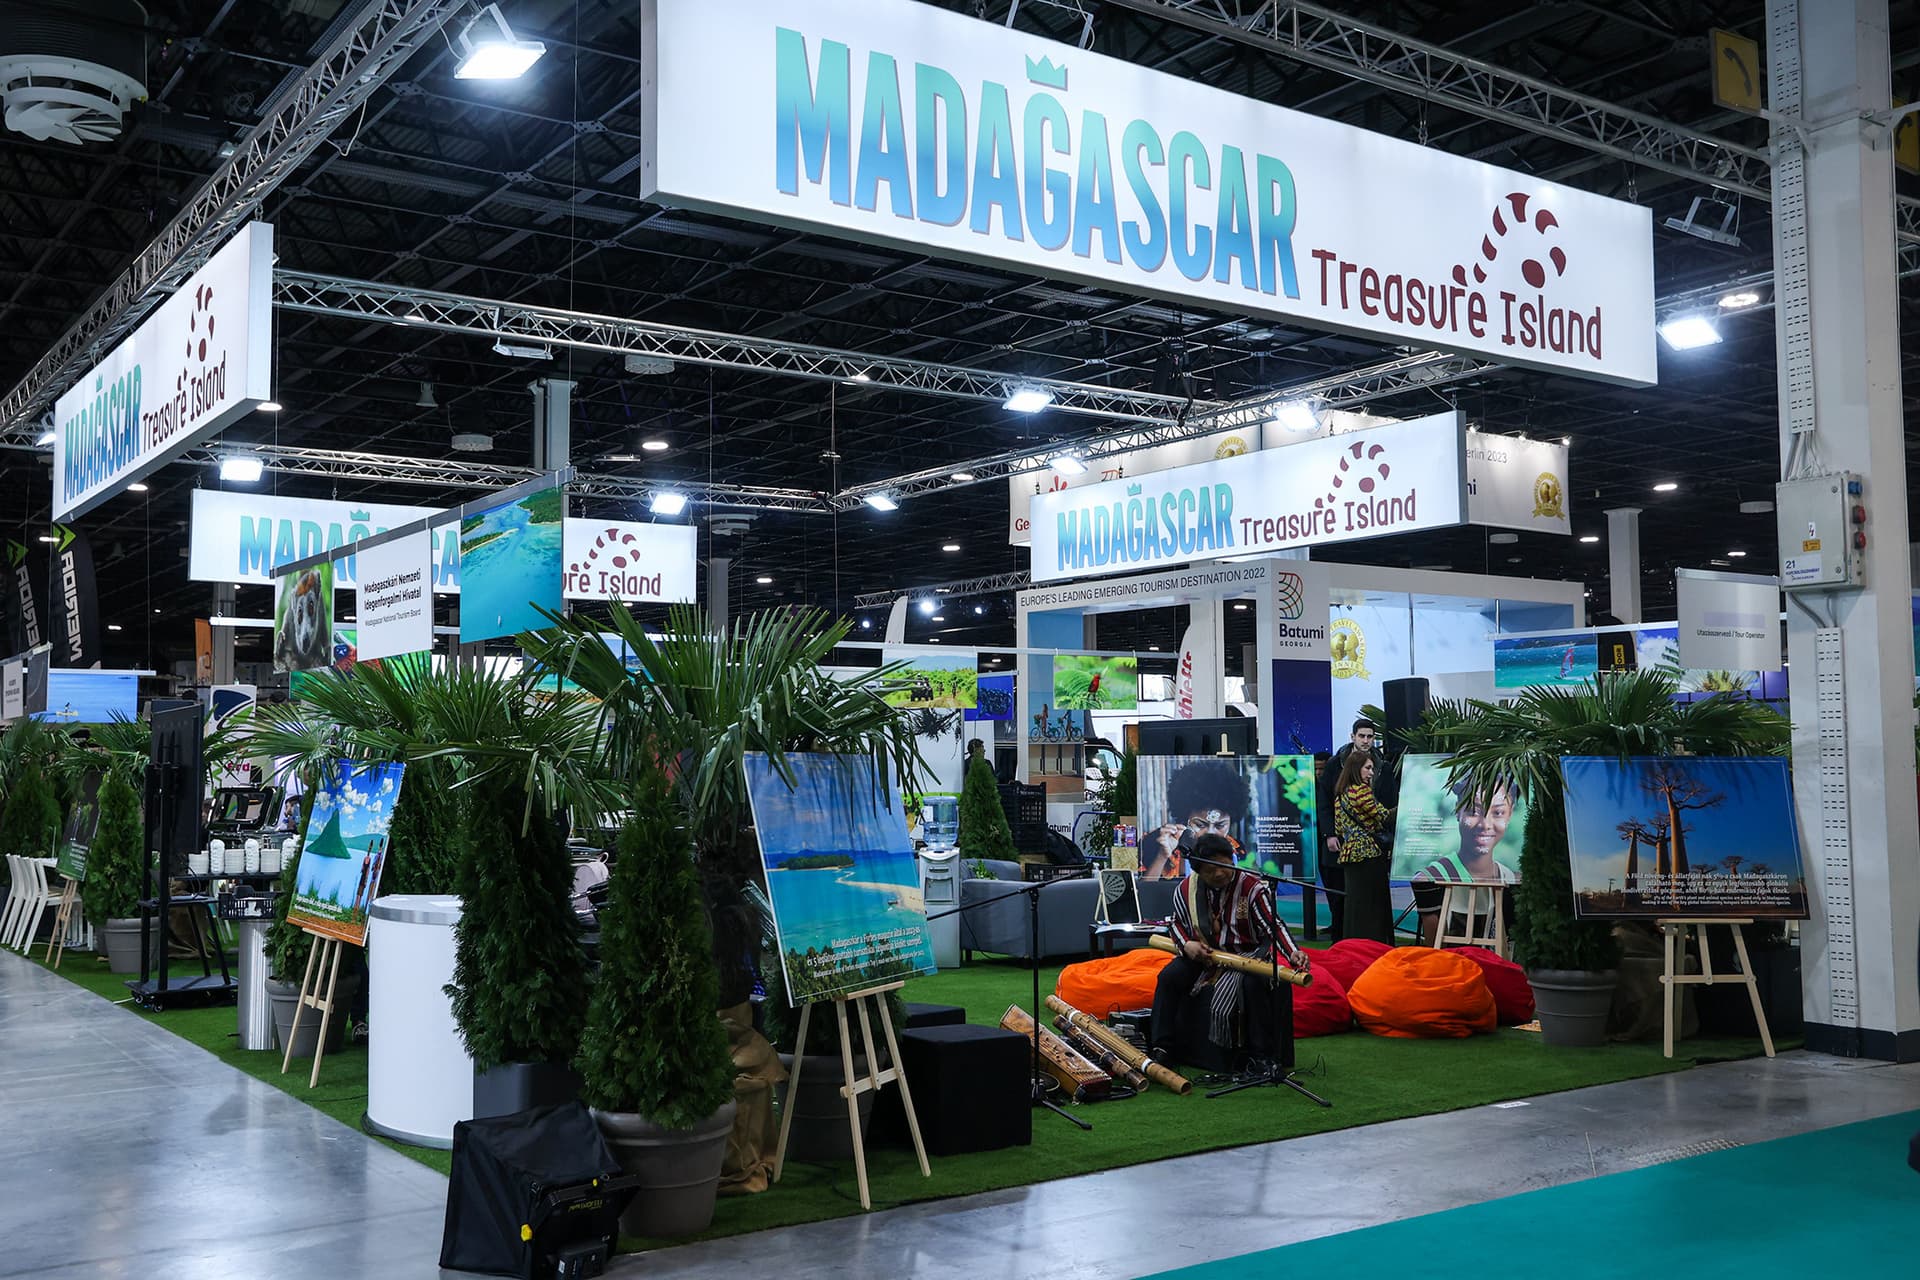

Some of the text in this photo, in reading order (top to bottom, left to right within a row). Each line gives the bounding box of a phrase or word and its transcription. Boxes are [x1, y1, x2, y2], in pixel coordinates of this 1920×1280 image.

[775, 27, 1602, 361] MADAGASCAR Treasure Island
[64, 350, 226, 504] MADAGASCAR Treasure Island
[1466, 448, 1508, 464] erlin 2023
[1057, 483, 1416, 571] MADAGASCAR Treasure Island
[1785, 560, 1796, 569] 21
[364, 568, 421, 594] Madagaszkári Nemzeti
[598, 571, 662, 597] Island
[1020, 567, 1266, 607] EUROPE'S LEADING EMERGING TOURISM DESTINATION 2022
[364, 586, 422, 611] Idegenforgalmi Hivatal
[1280, 623, 1324, 640] Batumi
[1745, 631, 1765, 639] Operator
[1049, 823, 1072, 833] atumi
